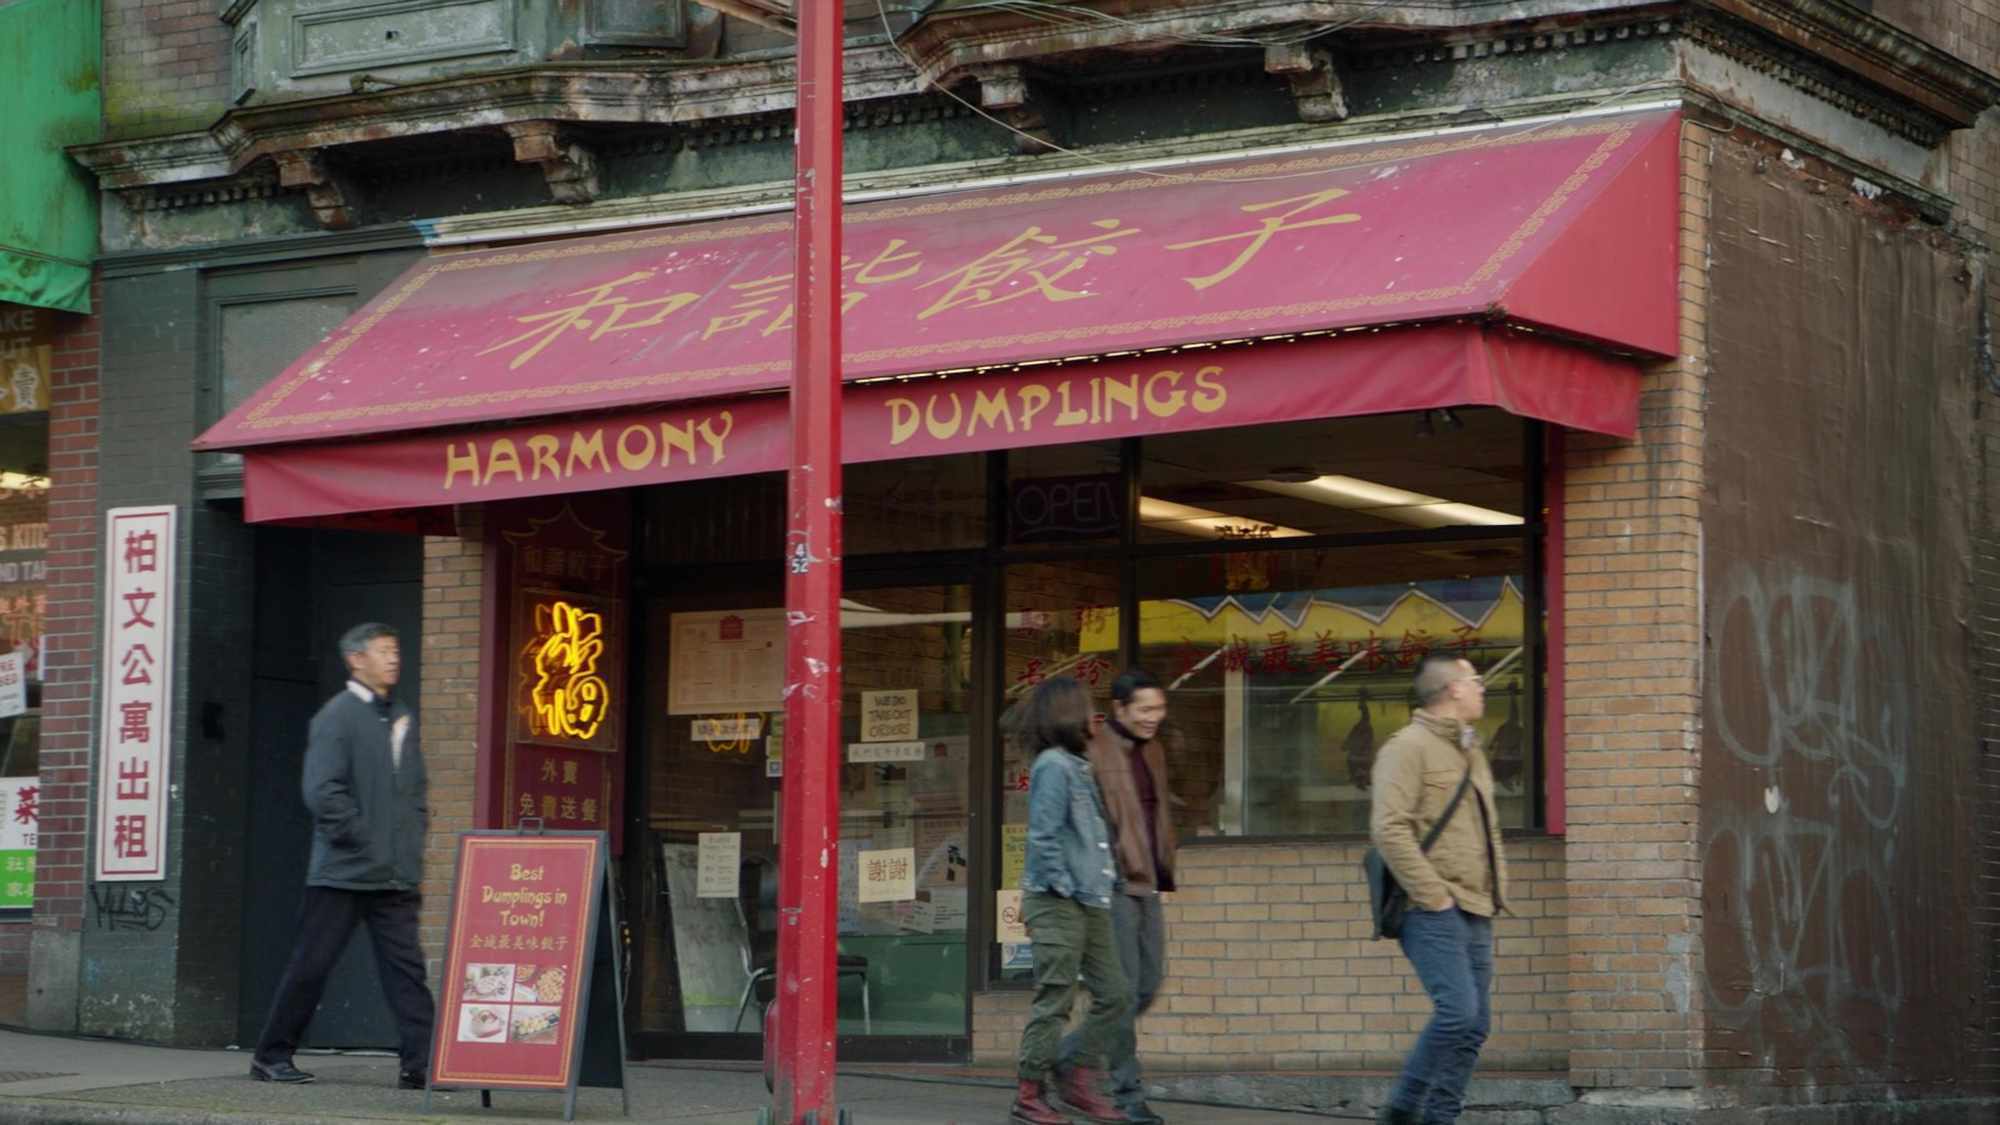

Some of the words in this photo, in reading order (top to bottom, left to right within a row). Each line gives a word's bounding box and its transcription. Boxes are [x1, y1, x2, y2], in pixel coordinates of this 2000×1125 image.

[0, 310, 35, 332] KE
[443, 411, 735, 491] HARMONY
[886, 364, 1229, 447] DUMPLINGS
[1016, 482, 1118, 524] OPEN
[113, 529, 158, 860] 柏文公寓出租
[510, 863, 545, 881] Best
[481, 885, 553, 910] Dumplings
[554, 887, 568, 906] in
[500, 909, 545, 929] Town!
